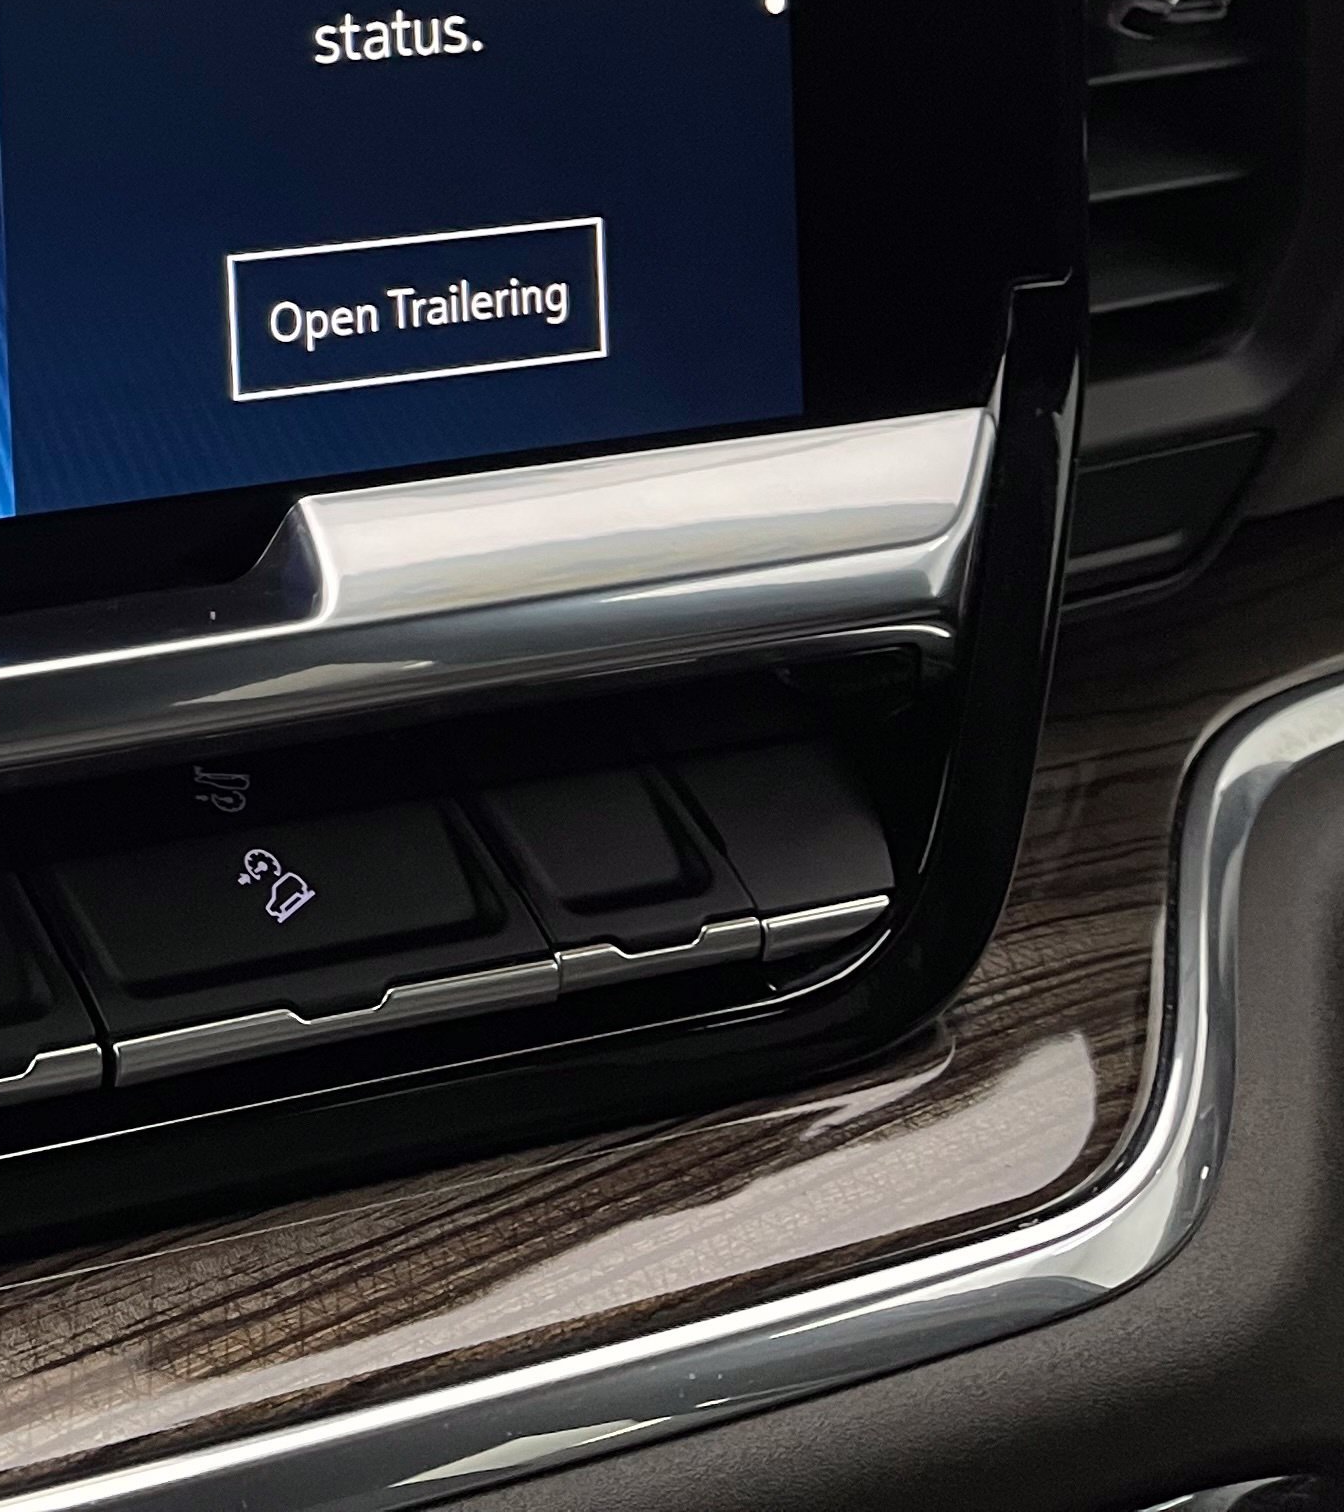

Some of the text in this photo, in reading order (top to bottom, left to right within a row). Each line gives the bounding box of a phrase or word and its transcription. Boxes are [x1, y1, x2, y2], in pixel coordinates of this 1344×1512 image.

[313, 8, 485, 66] status.
[269, 276, 569, 353] Open Trailering
